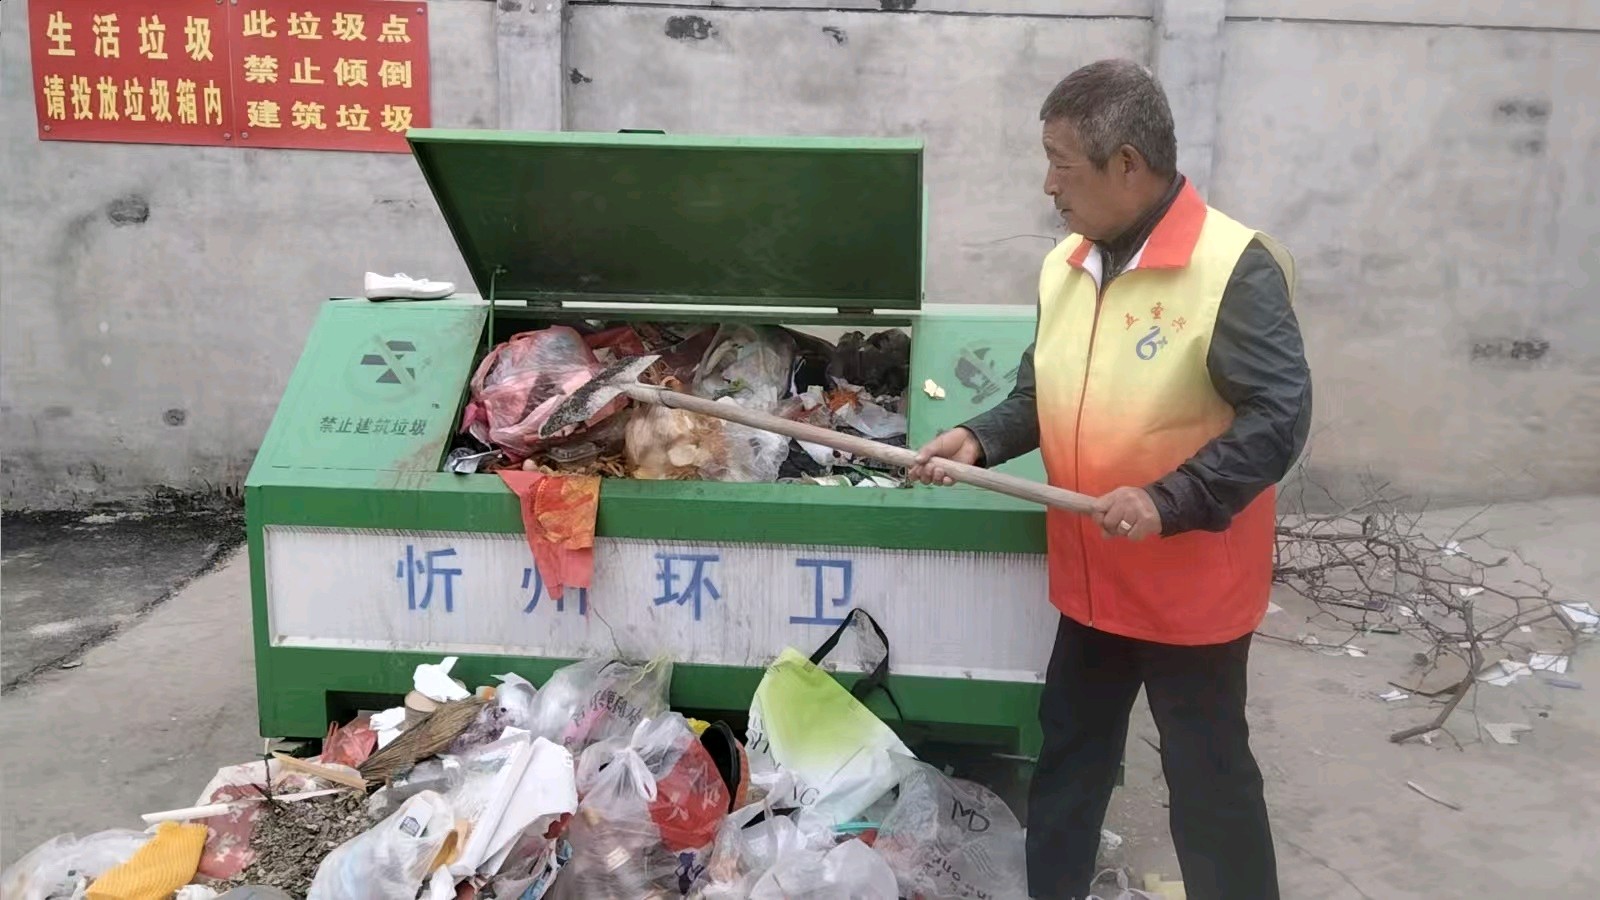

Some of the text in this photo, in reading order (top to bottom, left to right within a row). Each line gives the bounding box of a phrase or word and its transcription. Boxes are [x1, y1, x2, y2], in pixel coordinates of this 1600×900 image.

[46, 11, 214, 62] 生活垃圾
[242, 9, 412, 44] 此垃圾点
[243, 54, 413, 89] 禁止倾倒
[43, 74, 223, 126] 请投放垃圾箱内
[246, 100, 414, 133] 建筑垃圾
[319, 416, 428, 437] 禁止建筑垃圾
